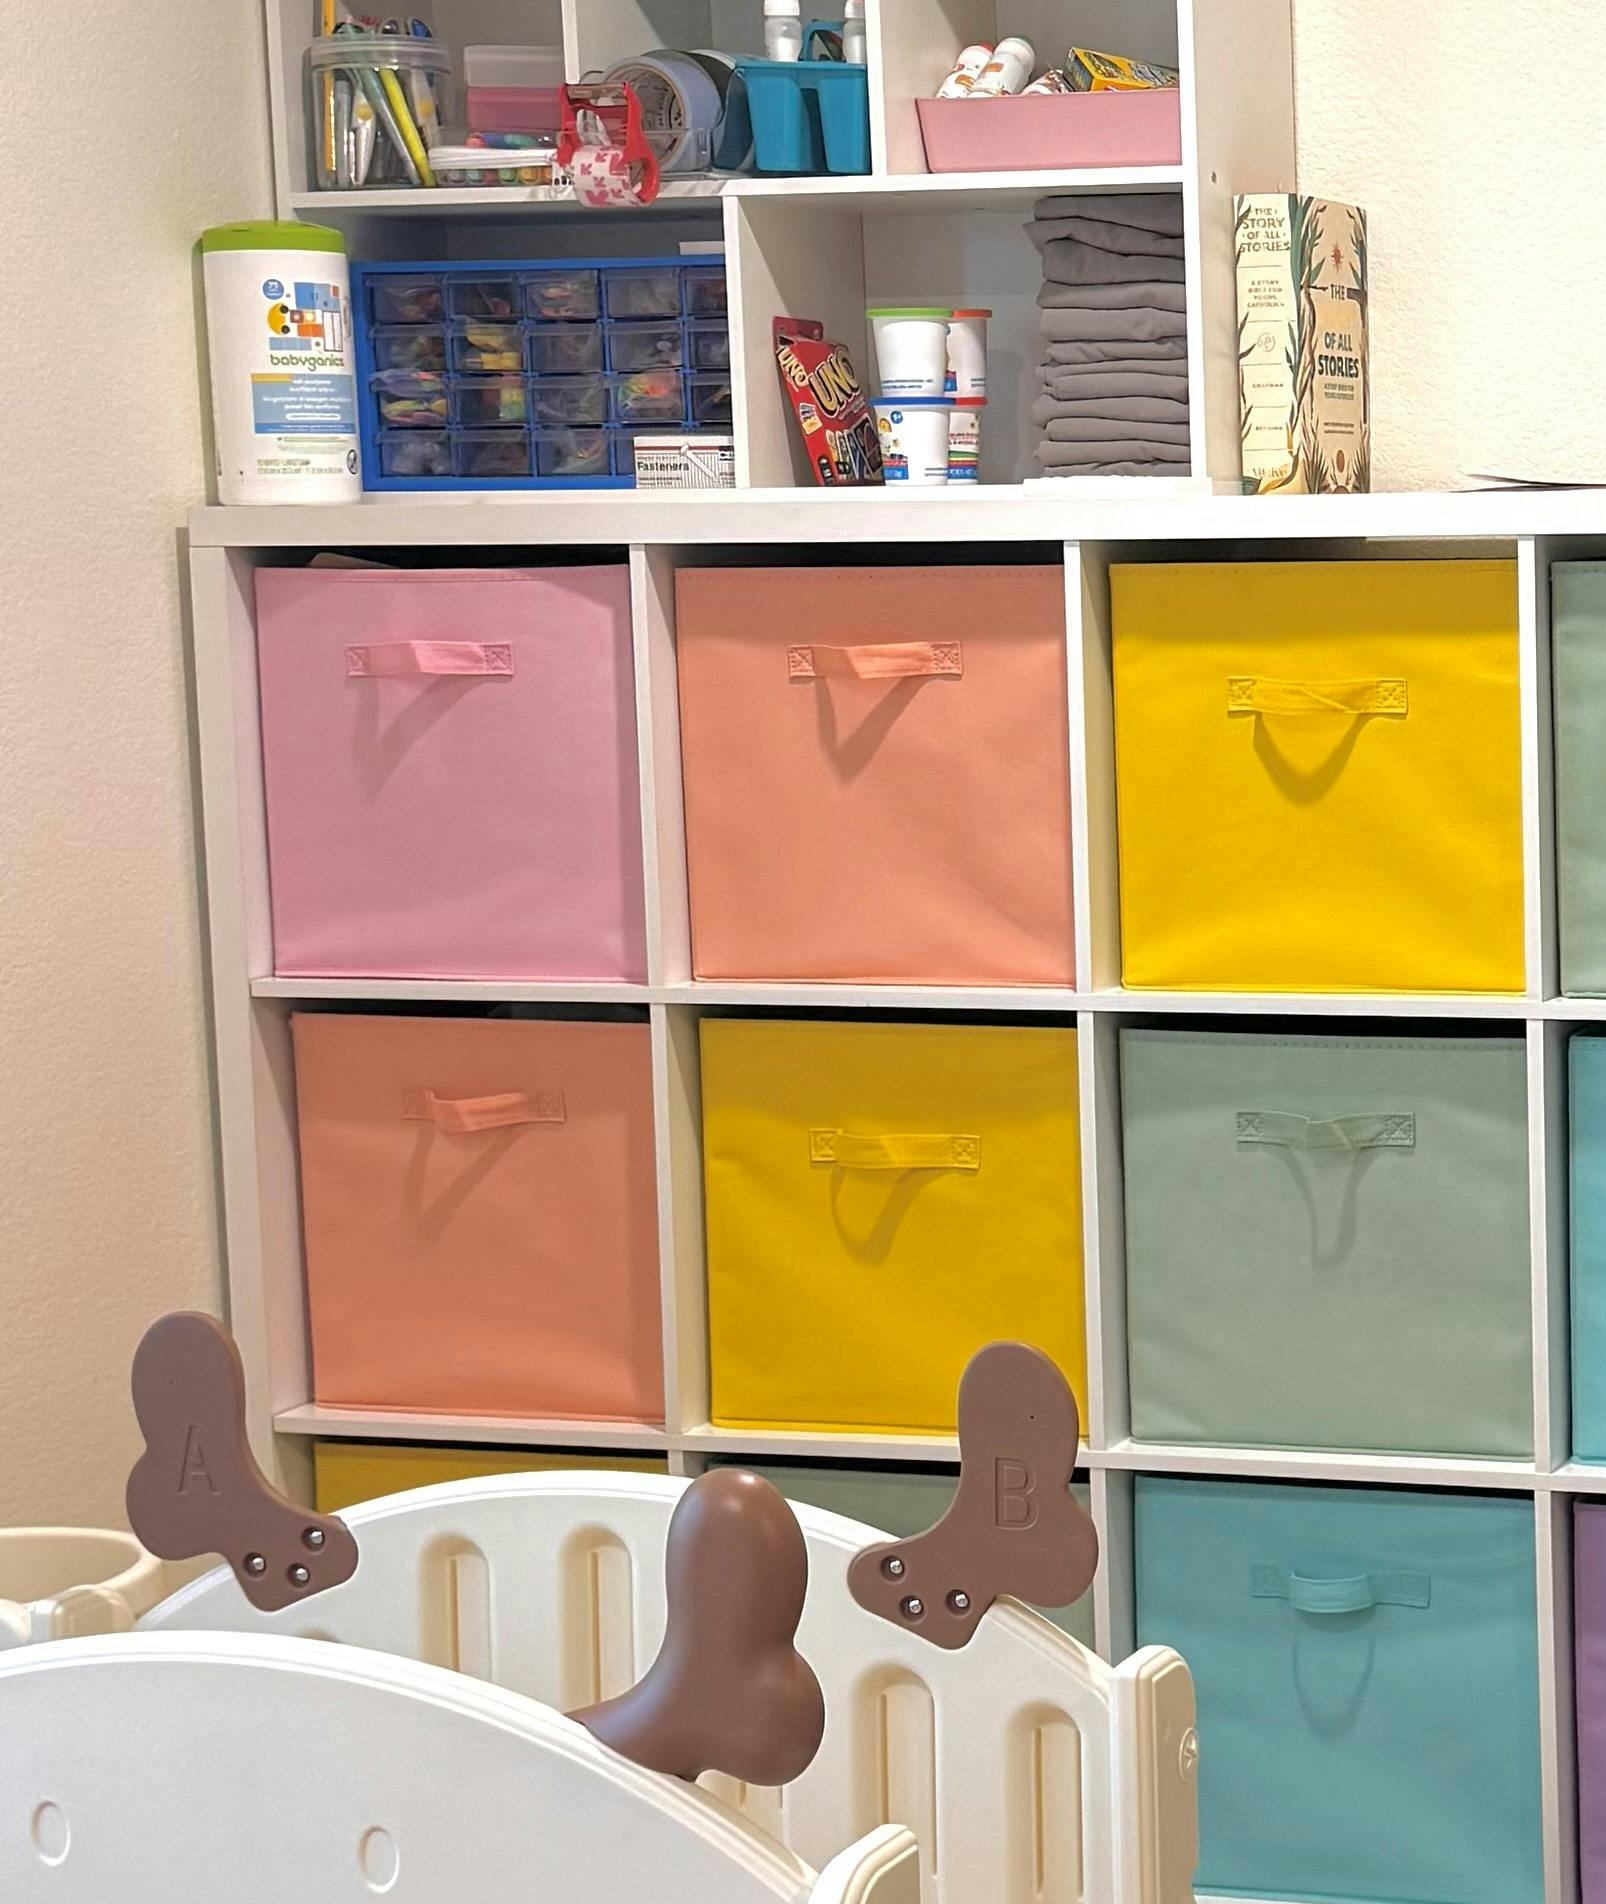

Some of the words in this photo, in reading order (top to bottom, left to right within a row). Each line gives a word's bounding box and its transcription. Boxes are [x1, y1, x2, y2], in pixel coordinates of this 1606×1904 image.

[1243, 217, 1285, 229] STORY
[1246, 231, 1261, 240] OF
[1330, 284, 1346, 301] THE
[1324, 332, 1338, 350] OF
[1337, 333, 1353, 352] ALL
[1318, 354, 1360, 379] STORIES
[808, 346, 860, 417] UNO
[178, 1422, 218, 1495] A
[995, 1457, 1037, 1530] B
